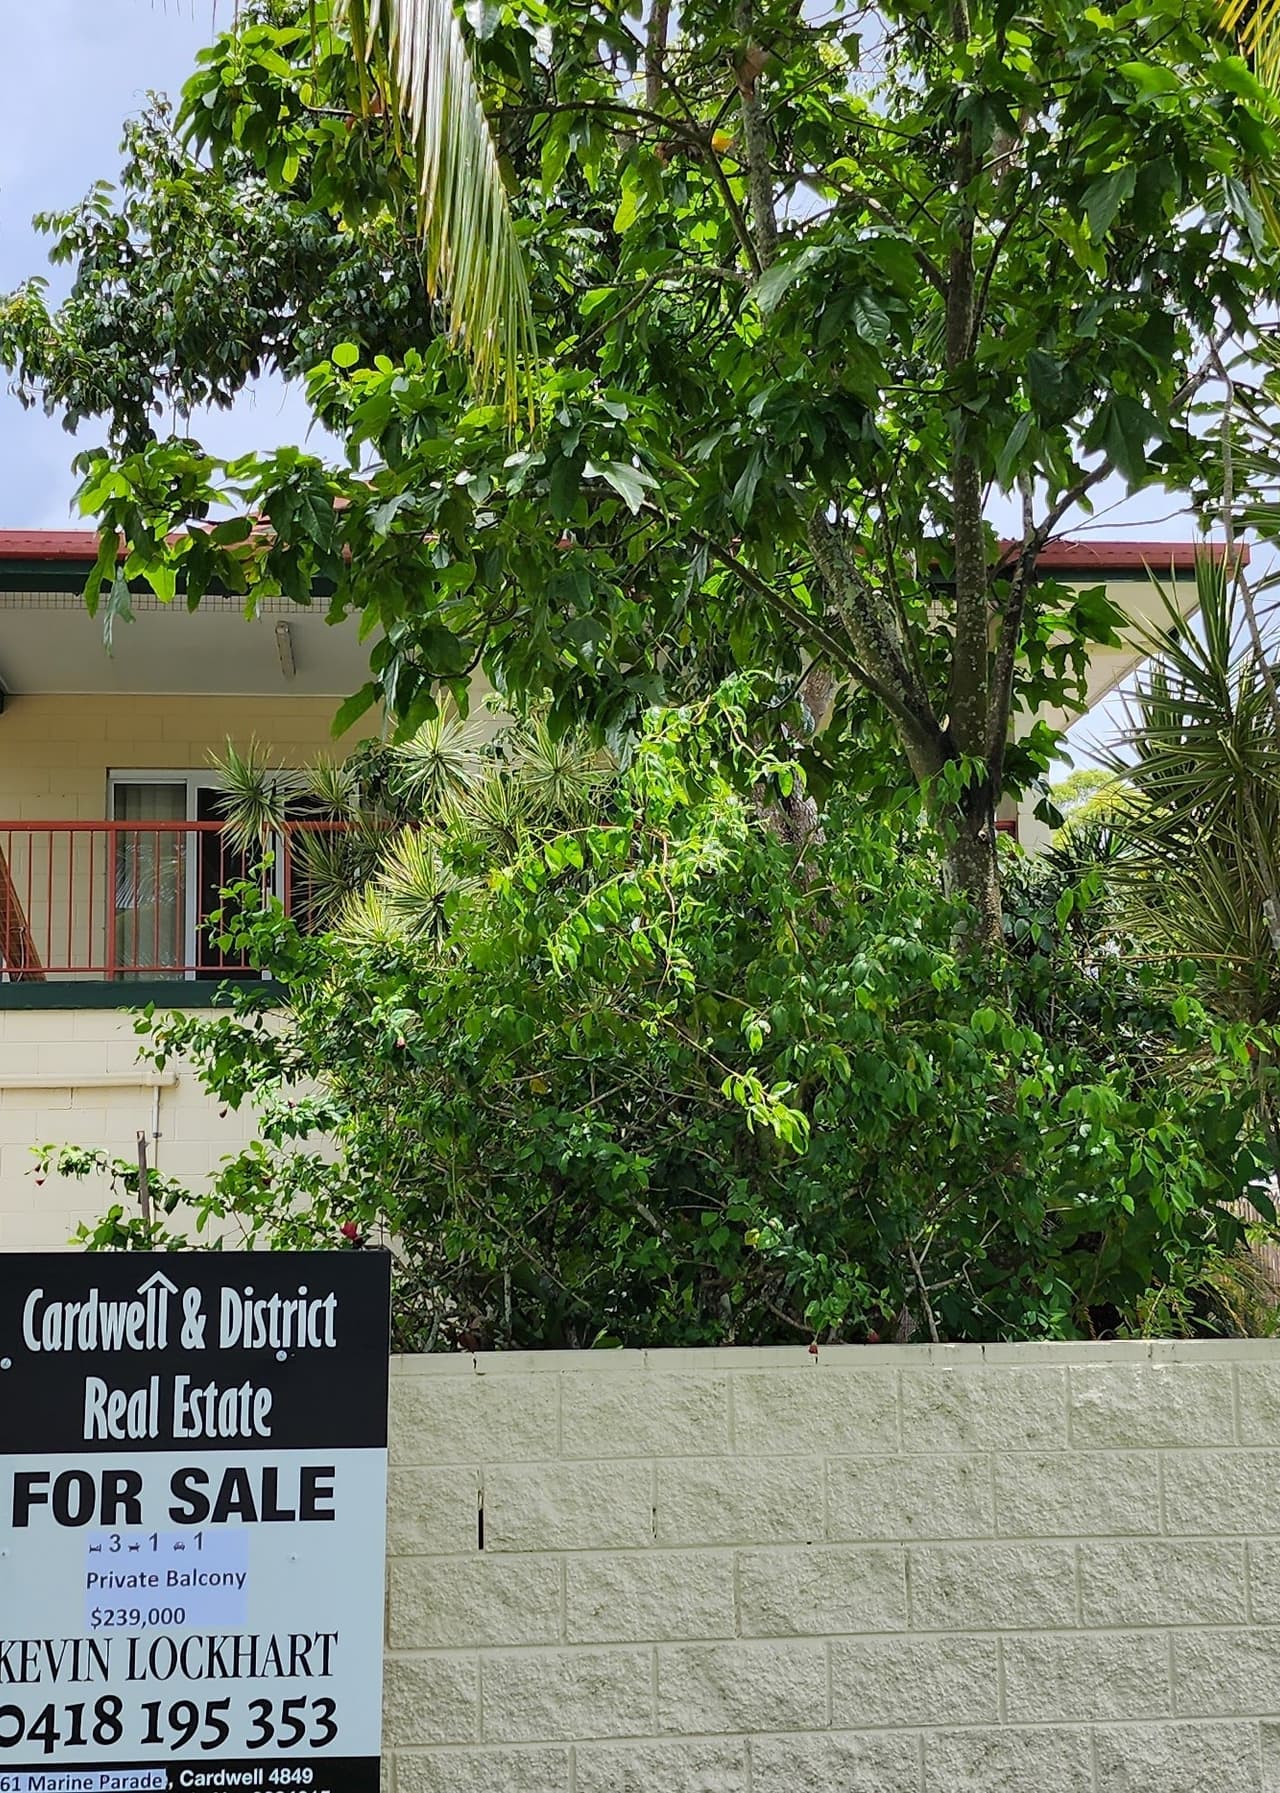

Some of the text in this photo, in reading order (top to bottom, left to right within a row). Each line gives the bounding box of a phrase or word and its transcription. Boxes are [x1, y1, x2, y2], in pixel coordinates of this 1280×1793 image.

[23, 1286, 337, 1352] Cardwell & District
[83, 1374, 273, 1440] Real Estate
[12, 1466, 336, 1528] FOR SALE
[109, 1531, 203, 1552] 3 1 1
[86, 1568, 247, 1589] Private Balcony
[90, 1606, 186, 1629] $239,000
[126, 1631, 339, 1682] LOCKHART
[140, 1695, 232, 1751] 195
[246, 1694, 339, 1749] 353
[0, 1776, 21, 1791] 61
[28, 1774, 93, 1791] Marine
[180, 1768, 263, 1787] Cardwell
[268, 1767, 314, 1785] 4849
